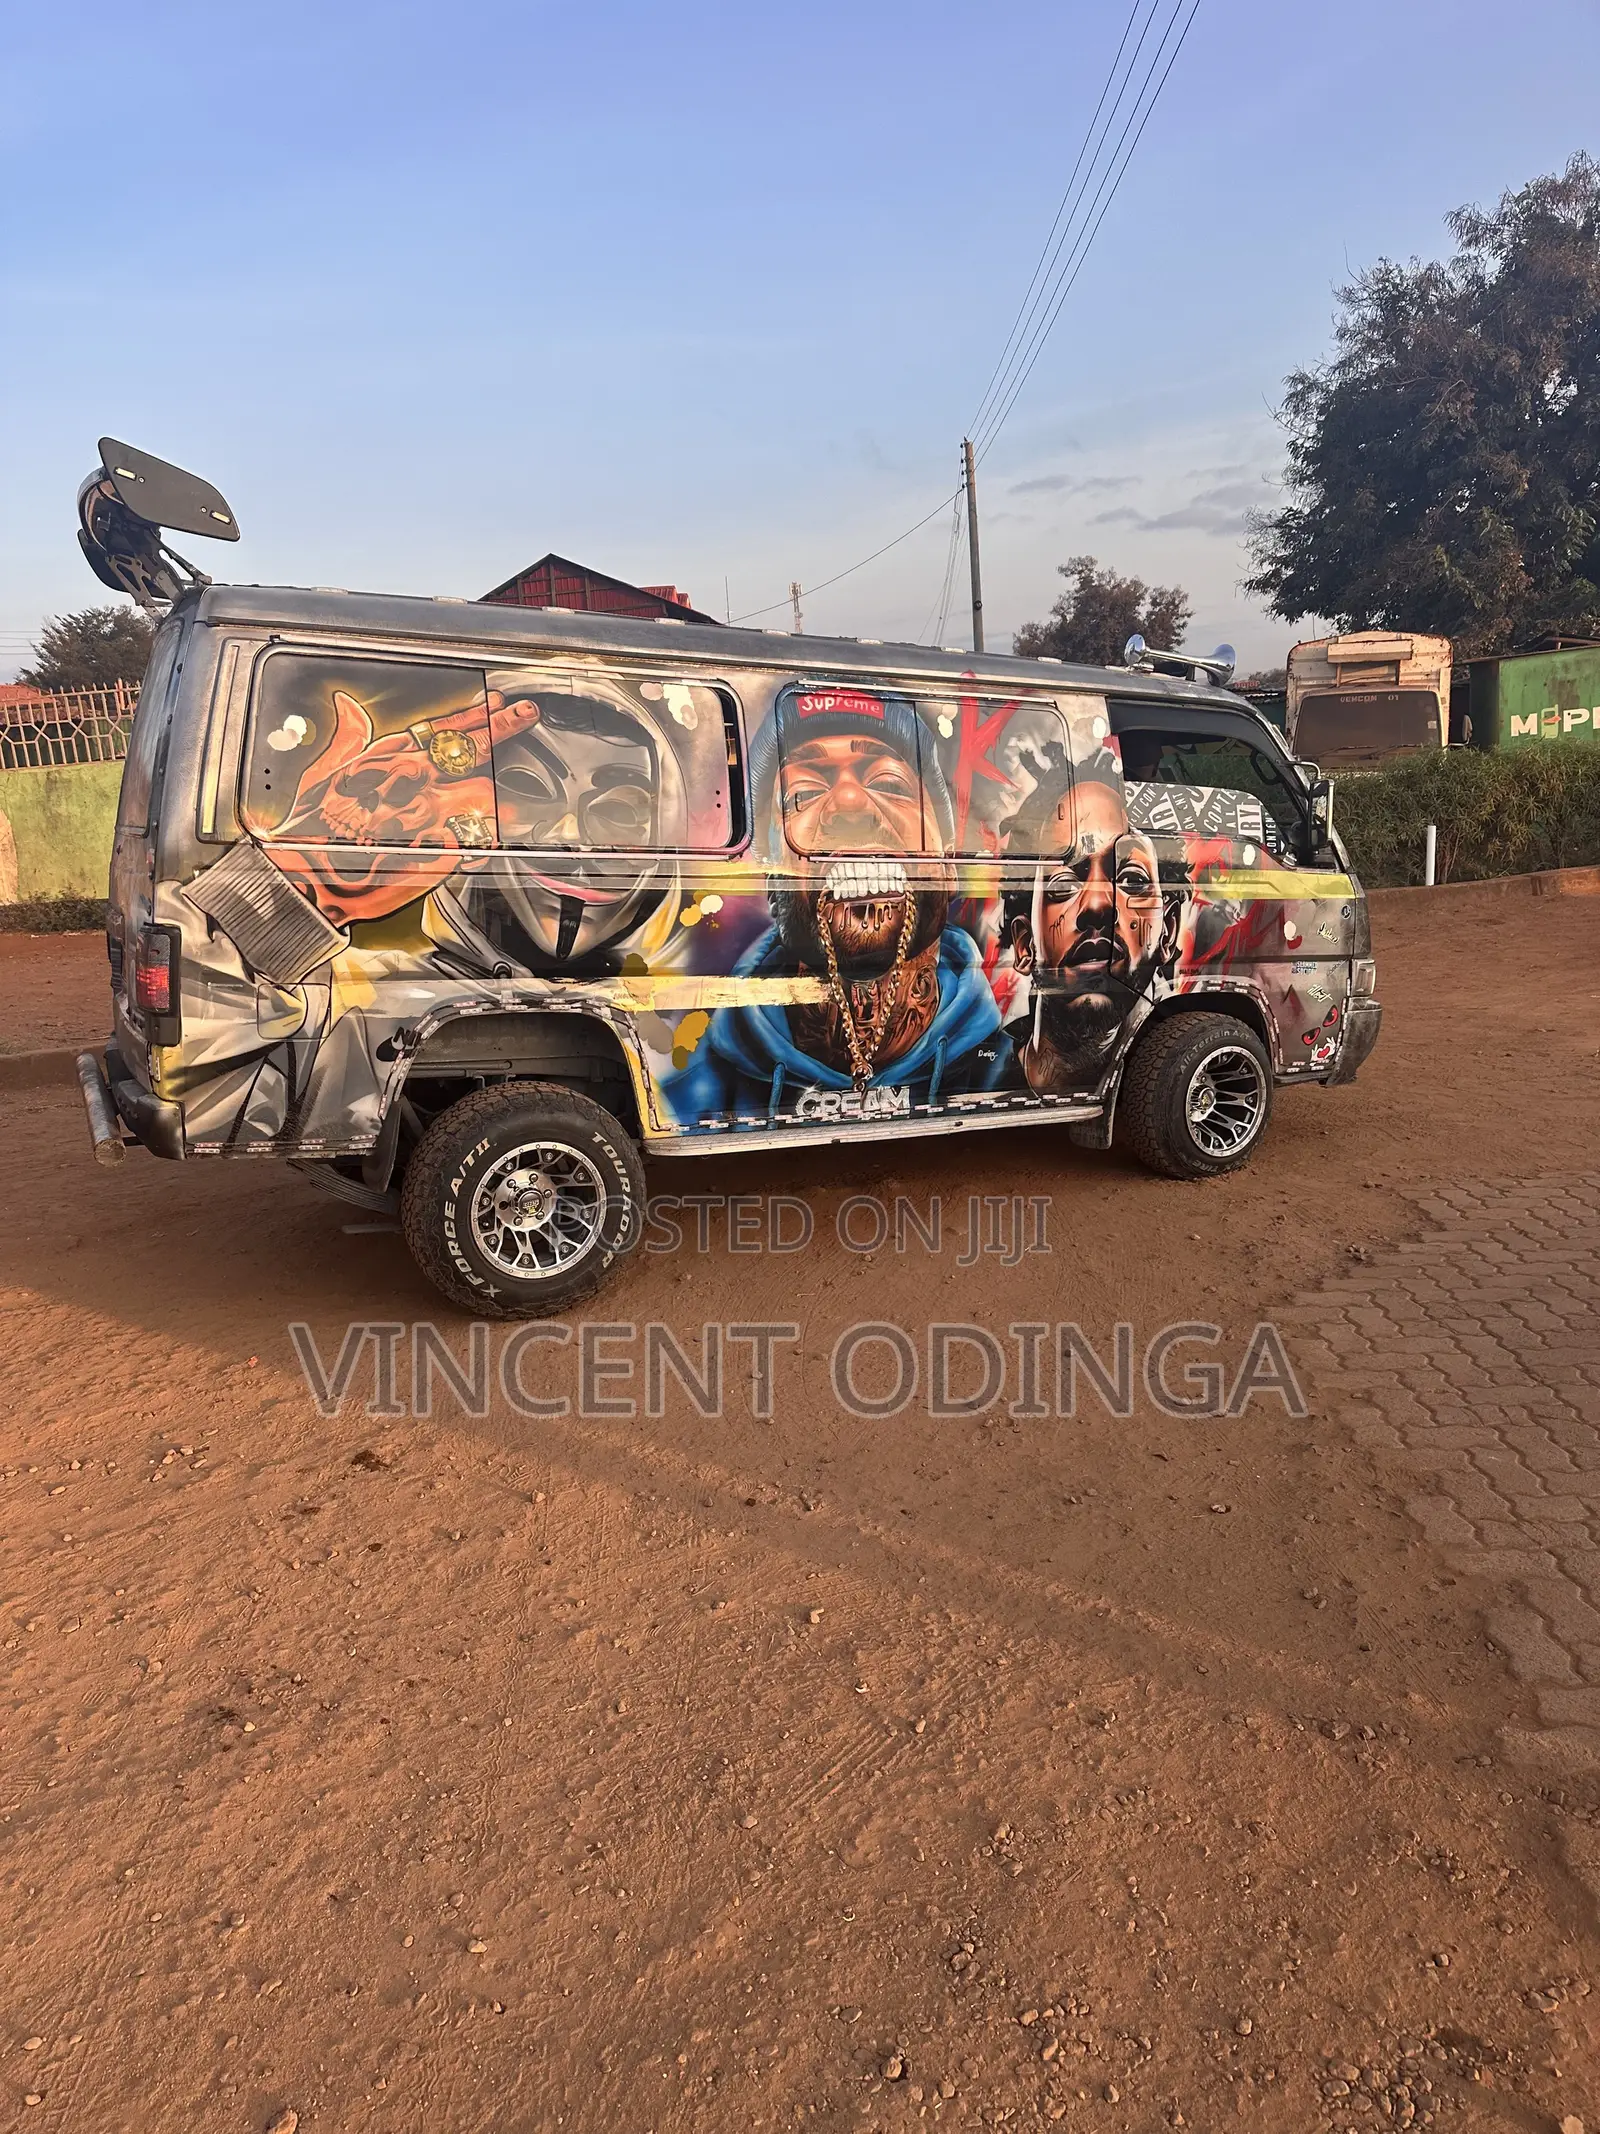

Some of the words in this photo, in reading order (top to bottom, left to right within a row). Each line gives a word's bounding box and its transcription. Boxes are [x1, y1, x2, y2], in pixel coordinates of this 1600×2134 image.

[802, 695, 880, 714] Supreme
[795, 1085, 911, 1120] CREAM
[591, 1131, 633, 1270] TOURADOR
[443, 1200, 485, 1287] FORCE
[481, 1283, 502, 1299] X
